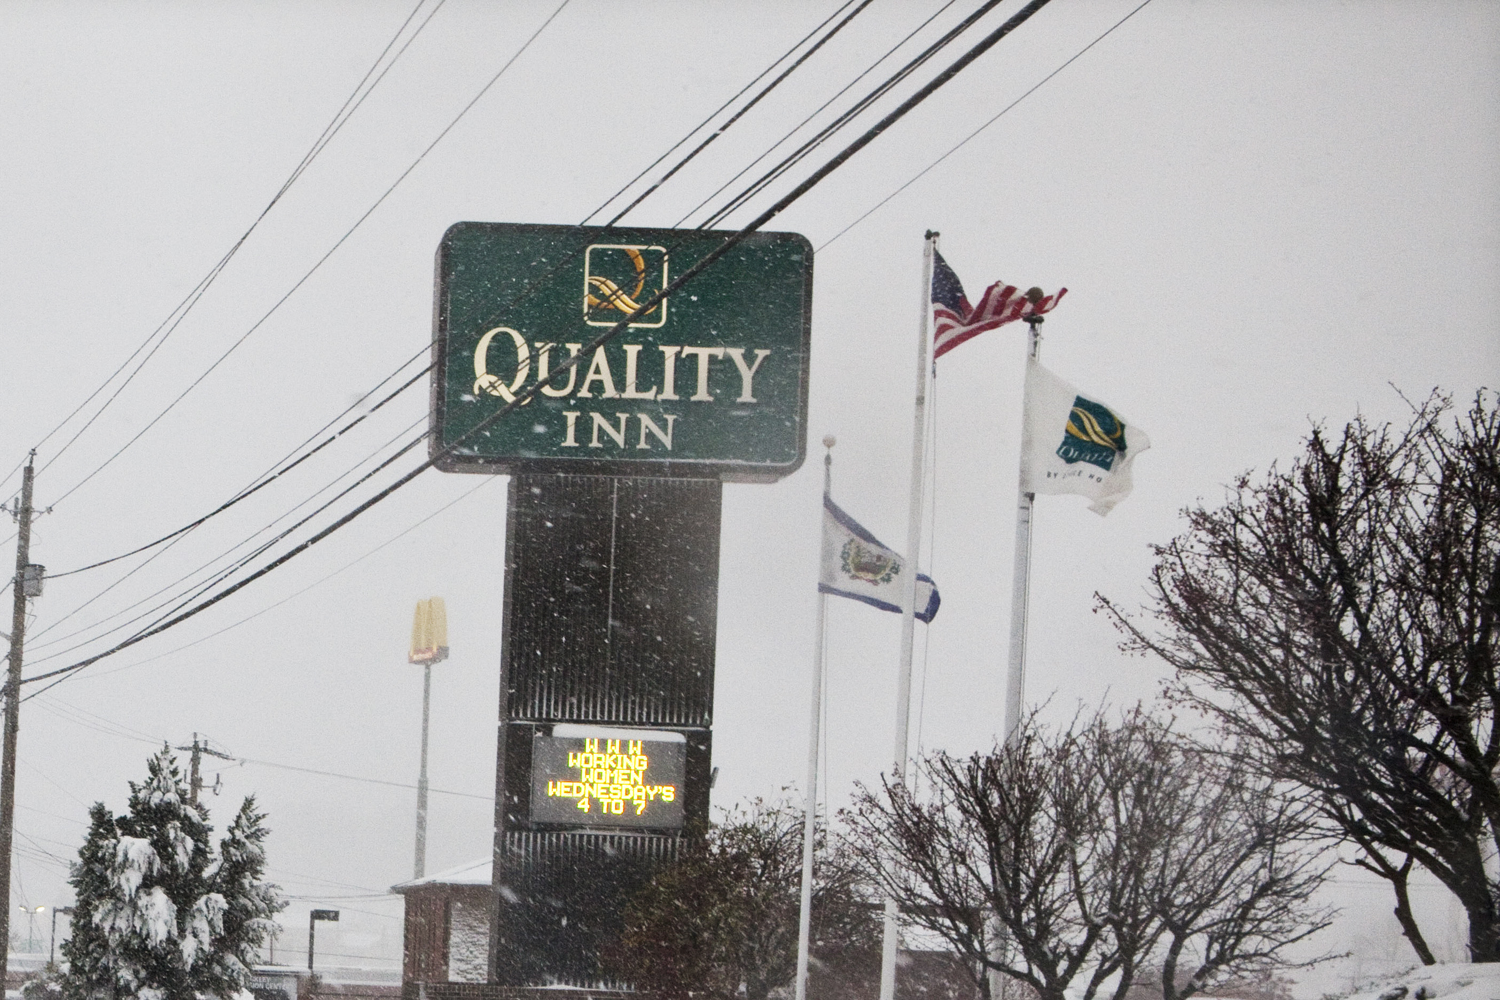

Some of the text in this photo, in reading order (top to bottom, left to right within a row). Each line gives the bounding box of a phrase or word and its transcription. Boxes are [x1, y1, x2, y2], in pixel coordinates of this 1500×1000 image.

[473, 326, 771, 406] QUALITY
[560, 410, 678, 451] INN
[568, 752, 648, 770] WORKING
[581, 767, 643, 785] WOMEN
[547, 781, 675, 802] WEDNESDAY'S
[576, 797, 647, 815] 4 TO 7
